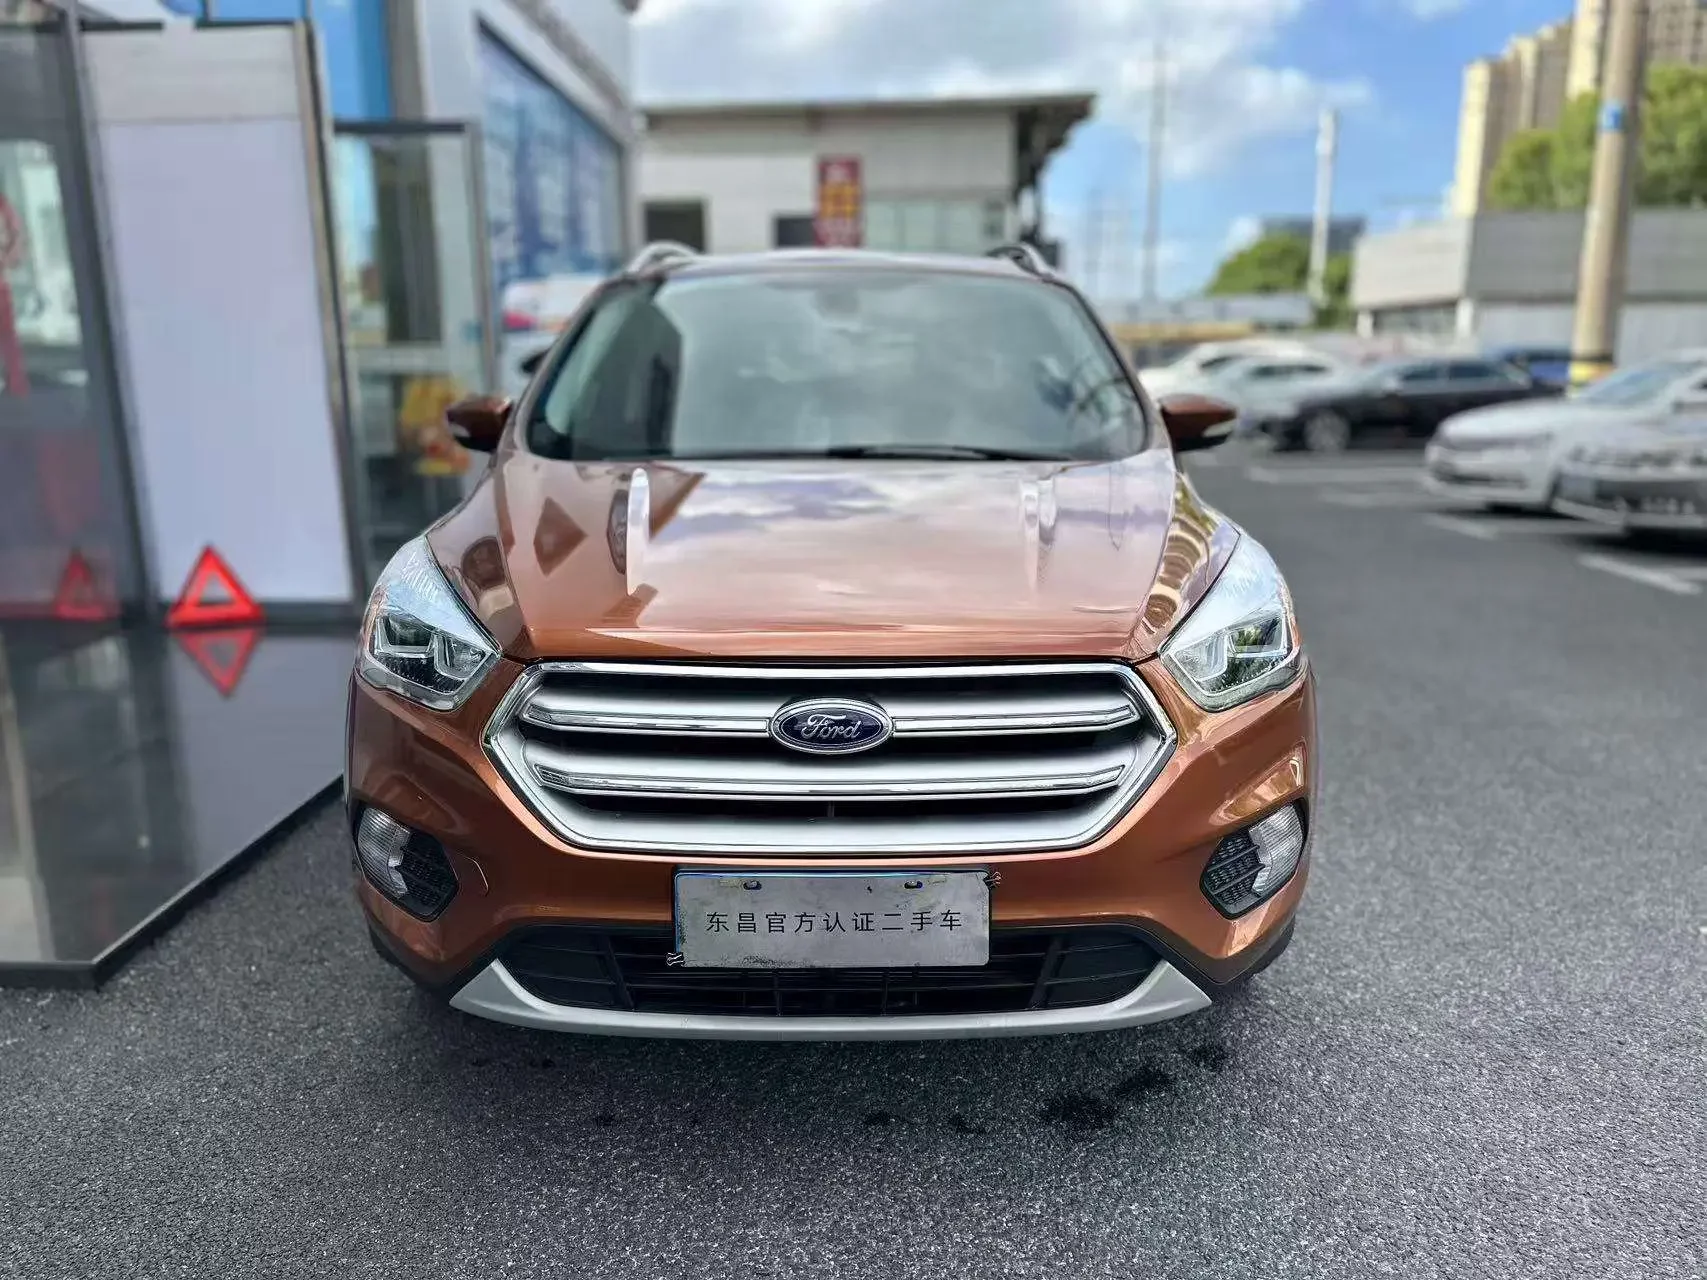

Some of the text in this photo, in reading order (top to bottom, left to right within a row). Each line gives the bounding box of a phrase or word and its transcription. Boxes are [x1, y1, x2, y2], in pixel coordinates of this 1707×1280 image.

[801, 713, 861, 739] Ford
[705, 910, 962, 934] 东昌官方认证二手车
